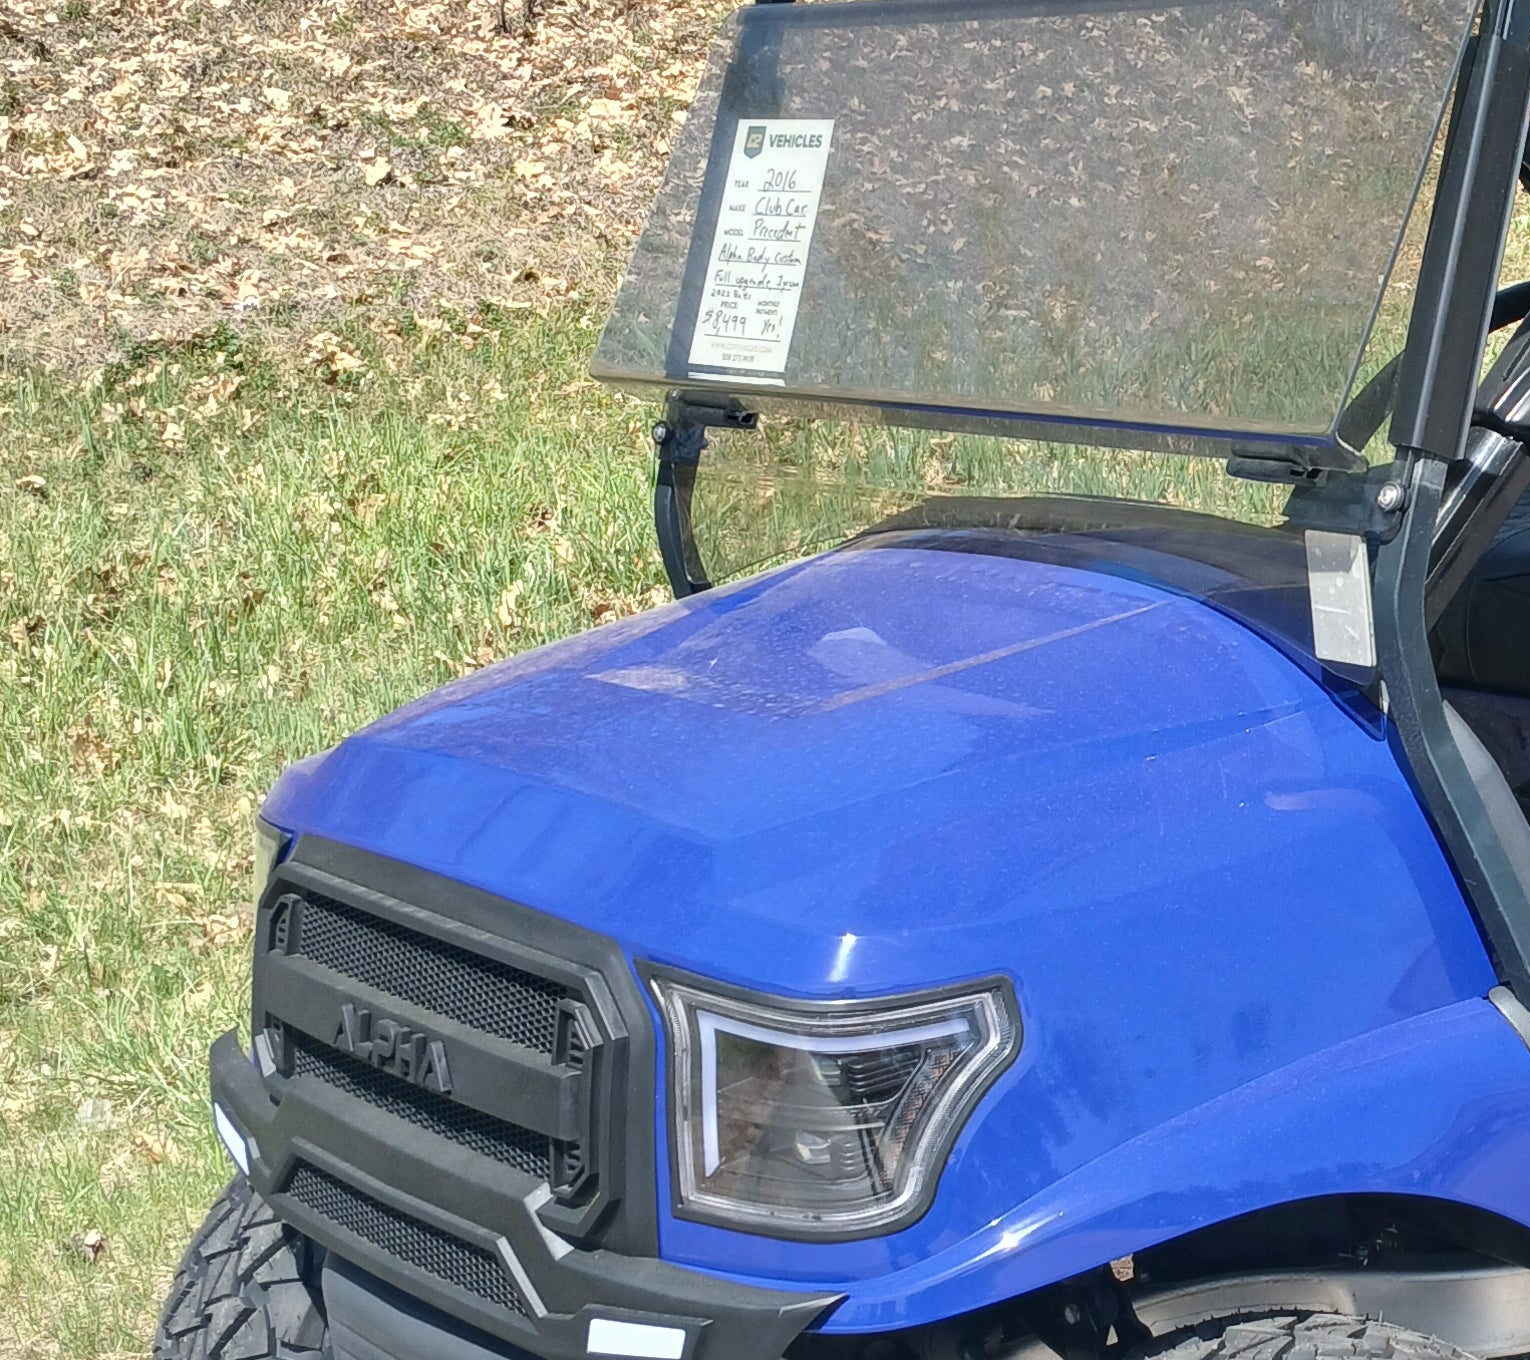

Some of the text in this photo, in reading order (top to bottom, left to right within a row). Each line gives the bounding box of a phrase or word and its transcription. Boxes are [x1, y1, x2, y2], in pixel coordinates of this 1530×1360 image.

[769, 134, 823, 148] VEHICLES
[763, 168, 797, 192] 2016
[755, 196, 782, 215] Club
[785, 198, 808, 216] Car
[333, 1003, 453, 1092] ALPHA
